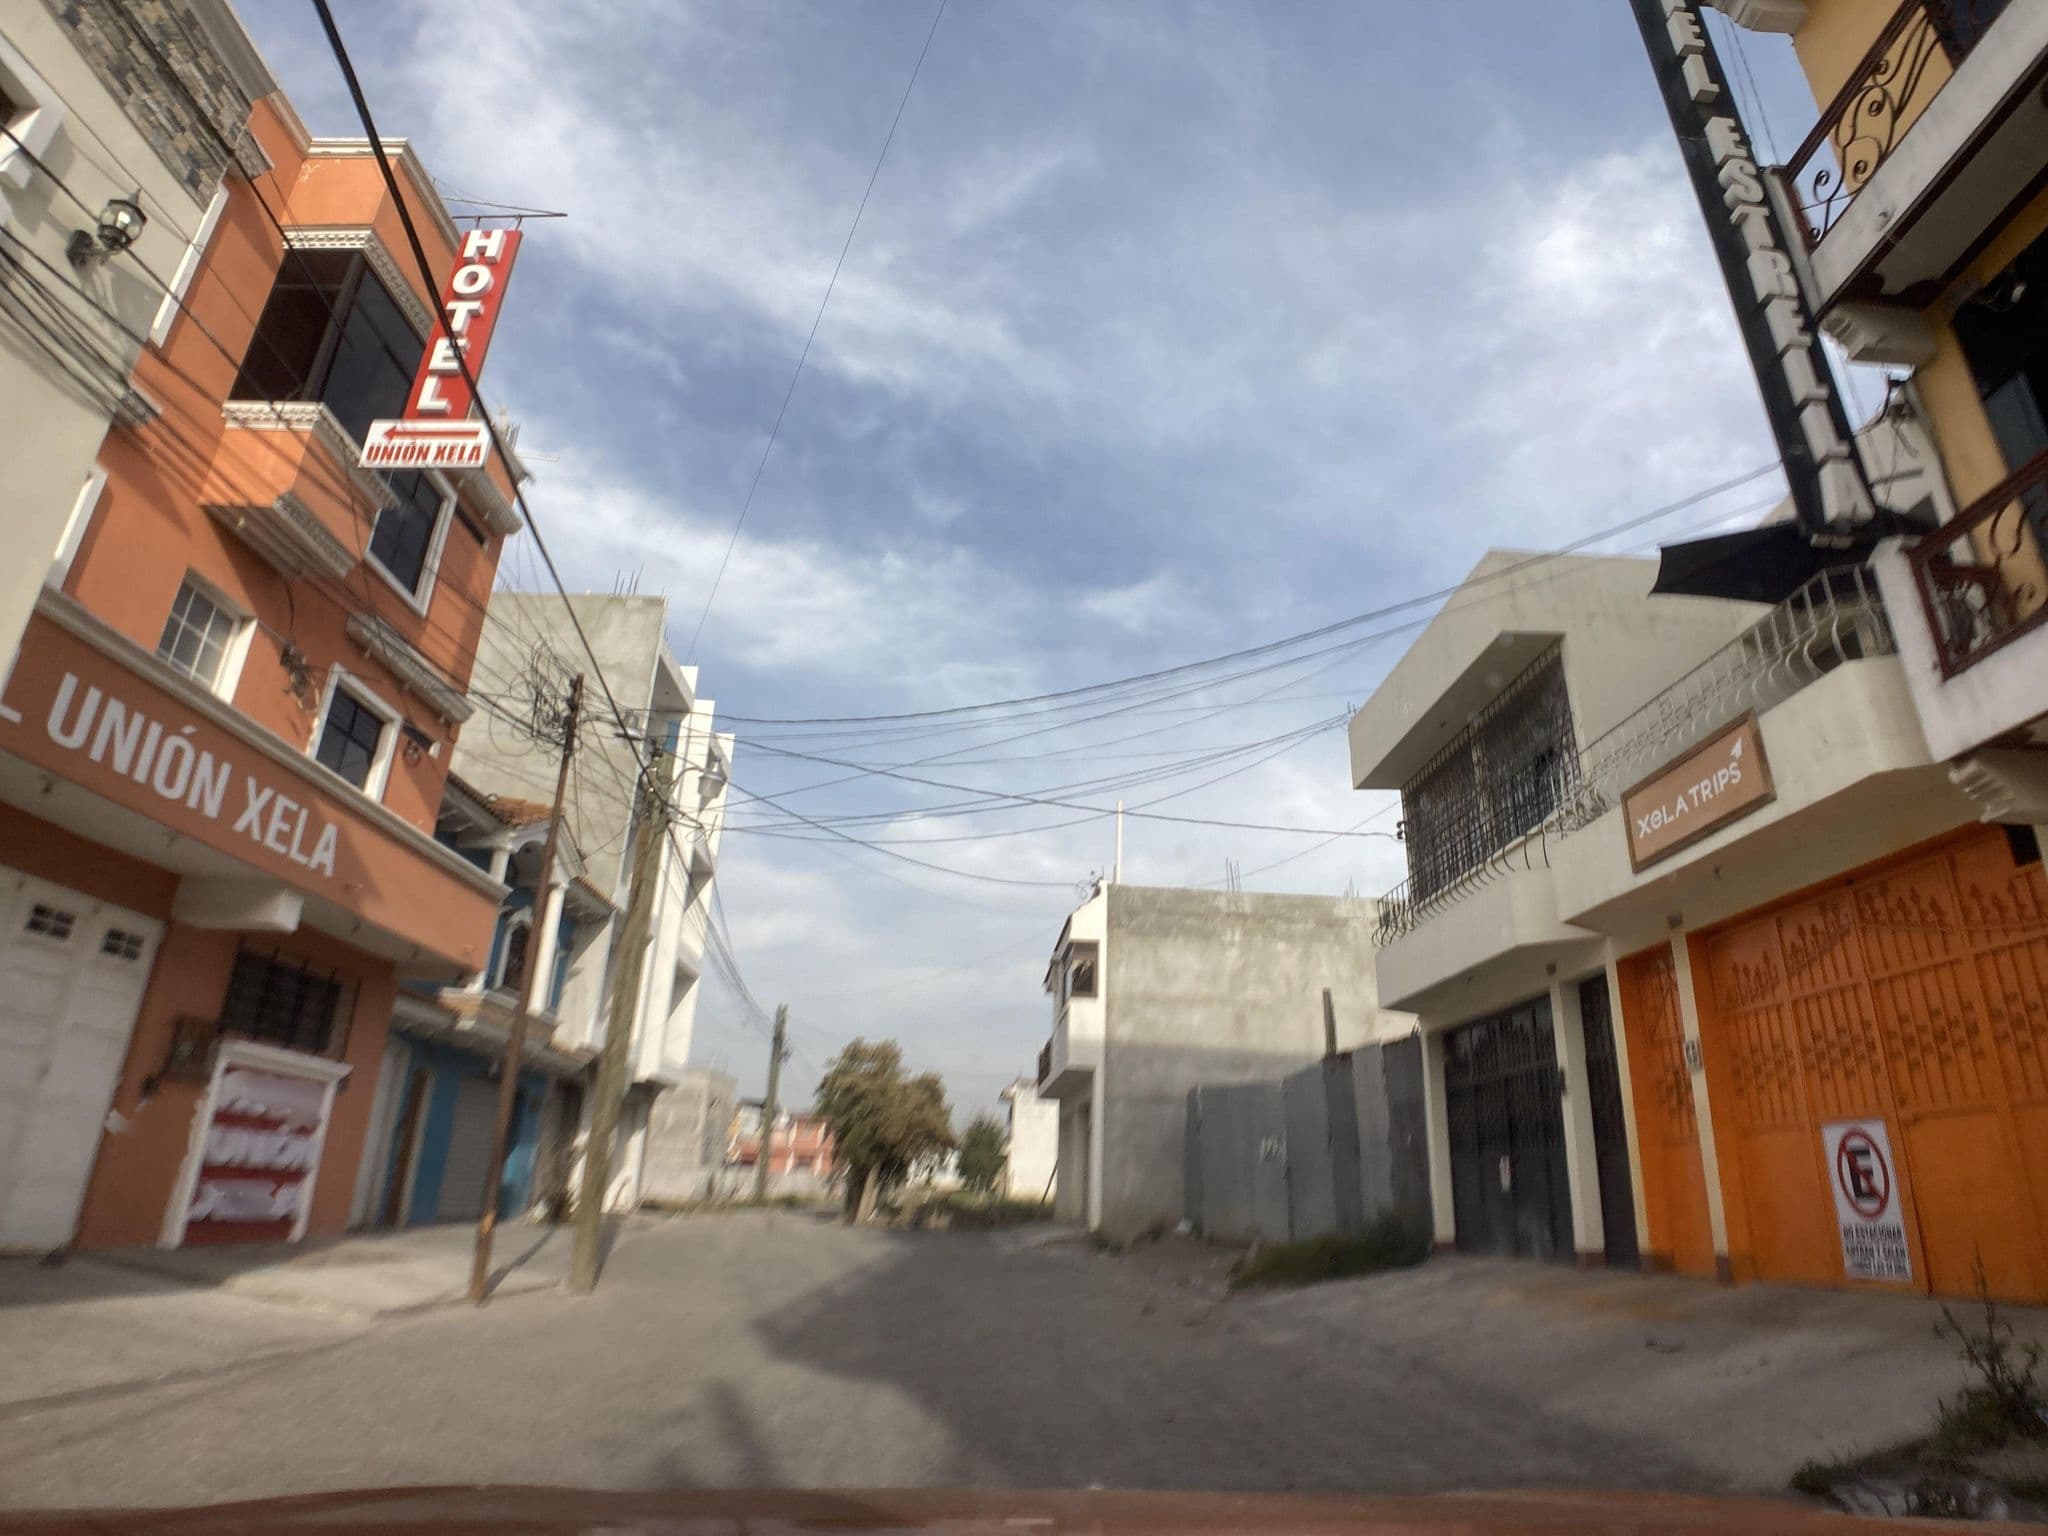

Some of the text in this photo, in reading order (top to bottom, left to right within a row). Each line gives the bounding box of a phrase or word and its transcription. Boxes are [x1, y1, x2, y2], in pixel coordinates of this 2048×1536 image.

[416, 229, 506, 414] HOTEL
[1703, 116, 1876, 526] ESTRELLA
[366, 441, 481, 464] UNIÓN XELA
[47, 672, 338, 878] UNIÓN XELA
[1689, 761, 1742, 806] TRIPS
